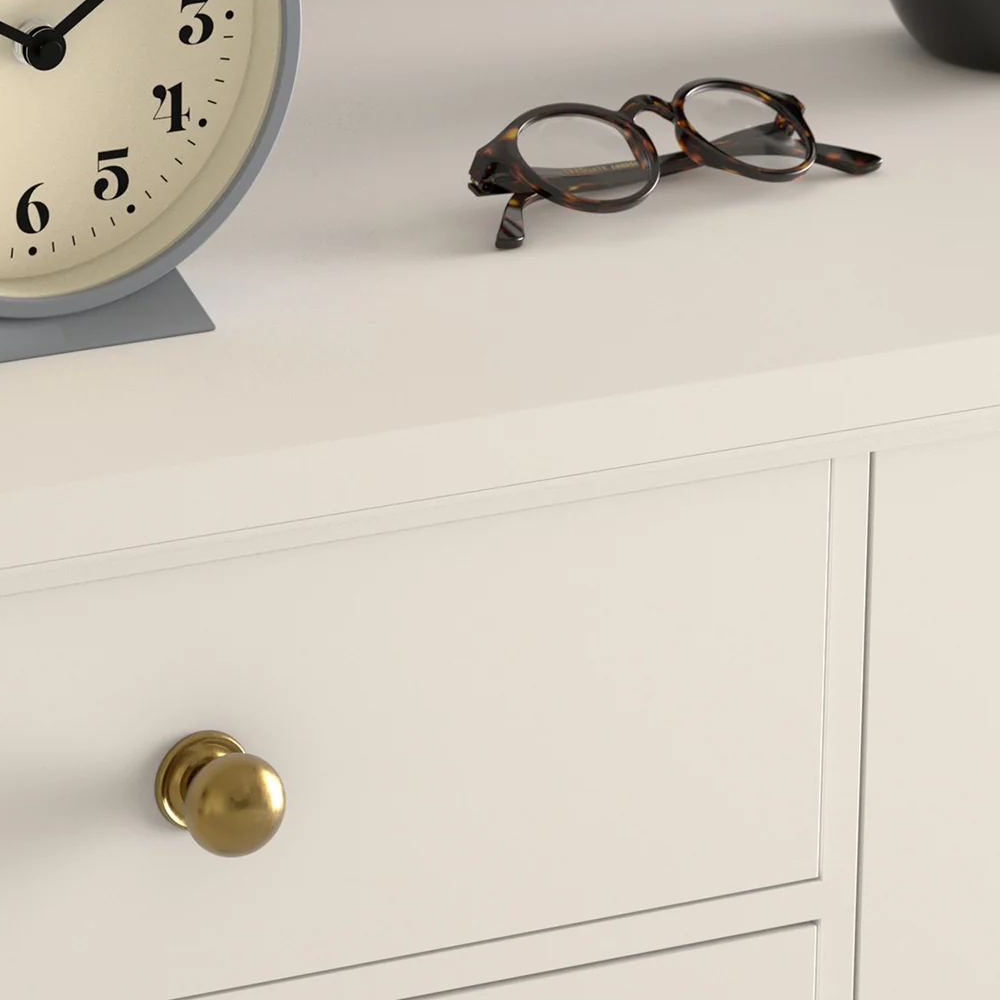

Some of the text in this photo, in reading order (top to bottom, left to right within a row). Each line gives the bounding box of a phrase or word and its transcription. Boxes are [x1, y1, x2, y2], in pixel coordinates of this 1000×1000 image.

[152, 81, 191, 134] 4
[93, 146, 130, 201] 5
[15, 182, 50, 235] 6
